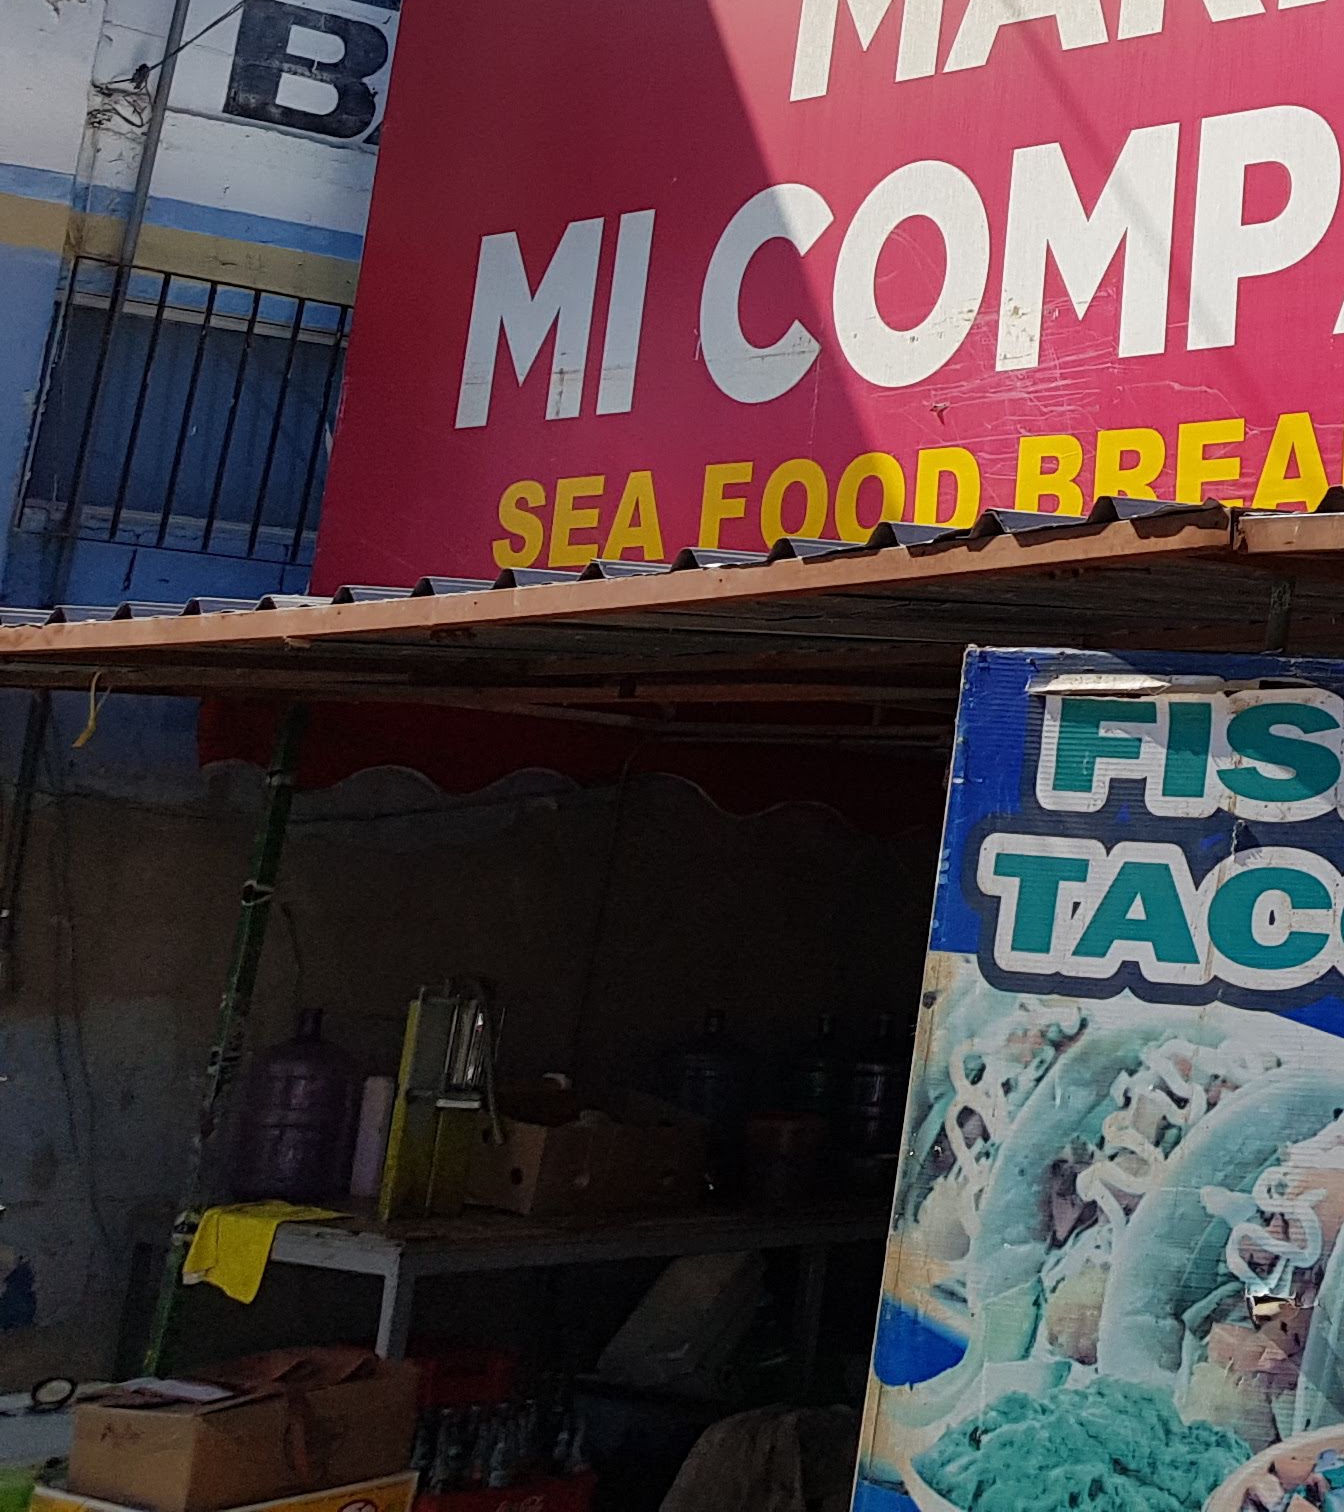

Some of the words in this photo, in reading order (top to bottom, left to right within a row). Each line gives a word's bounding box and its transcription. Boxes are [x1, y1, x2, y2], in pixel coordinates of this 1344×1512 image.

[453, 209, 656, 430] MI
[492, 470, 665, 570] SEA
[699, 447, 981, 549] FOOD
